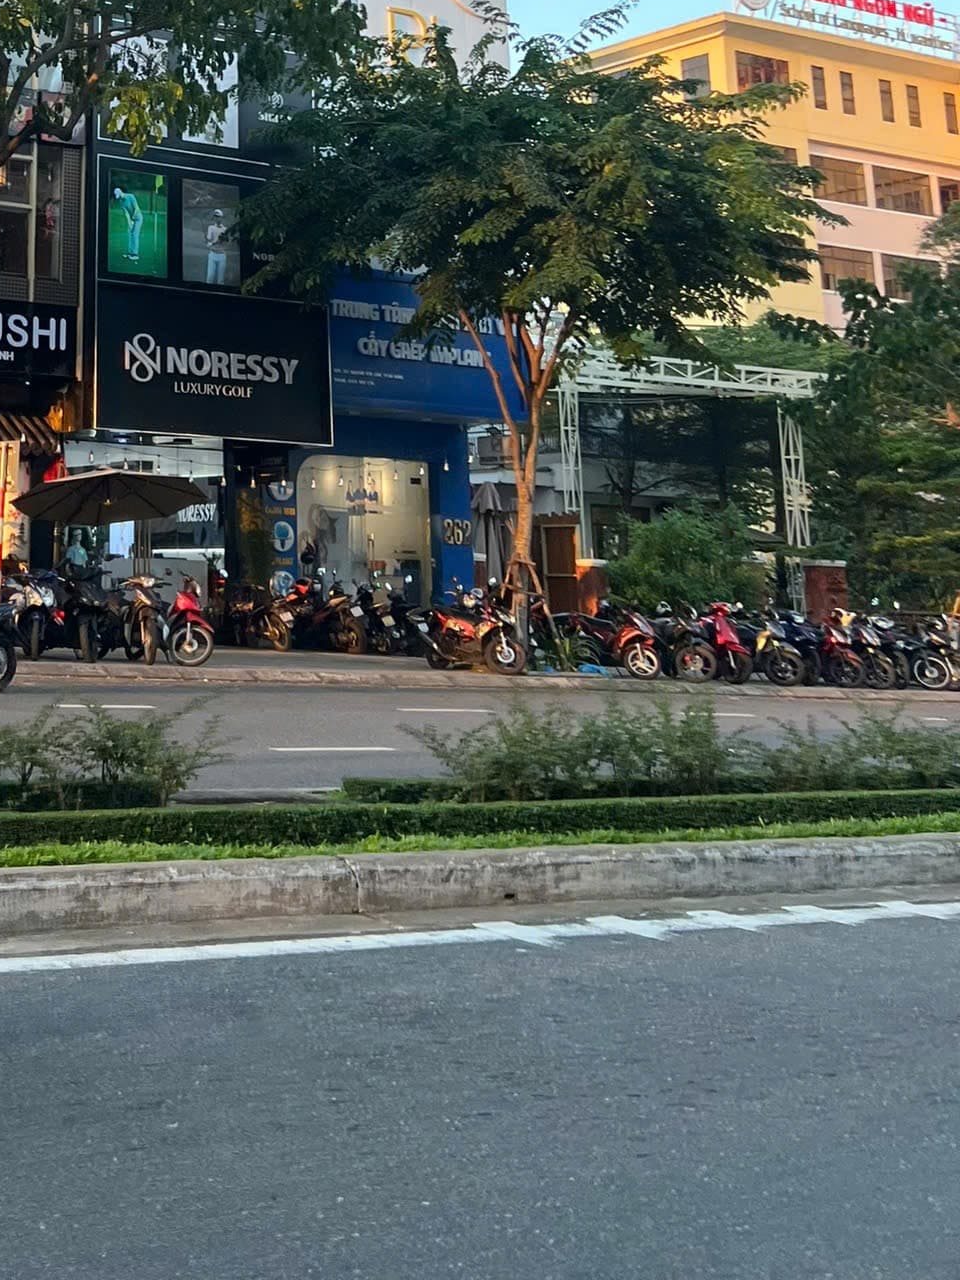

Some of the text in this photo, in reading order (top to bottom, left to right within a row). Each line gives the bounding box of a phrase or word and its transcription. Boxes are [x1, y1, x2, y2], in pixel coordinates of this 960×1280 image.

[778, 1, 817, 23] School
[330, 298, 380, 322] TRUNG
[166, 346, 299, 385] NORESSY
[443, 518, 472, 545] 262
